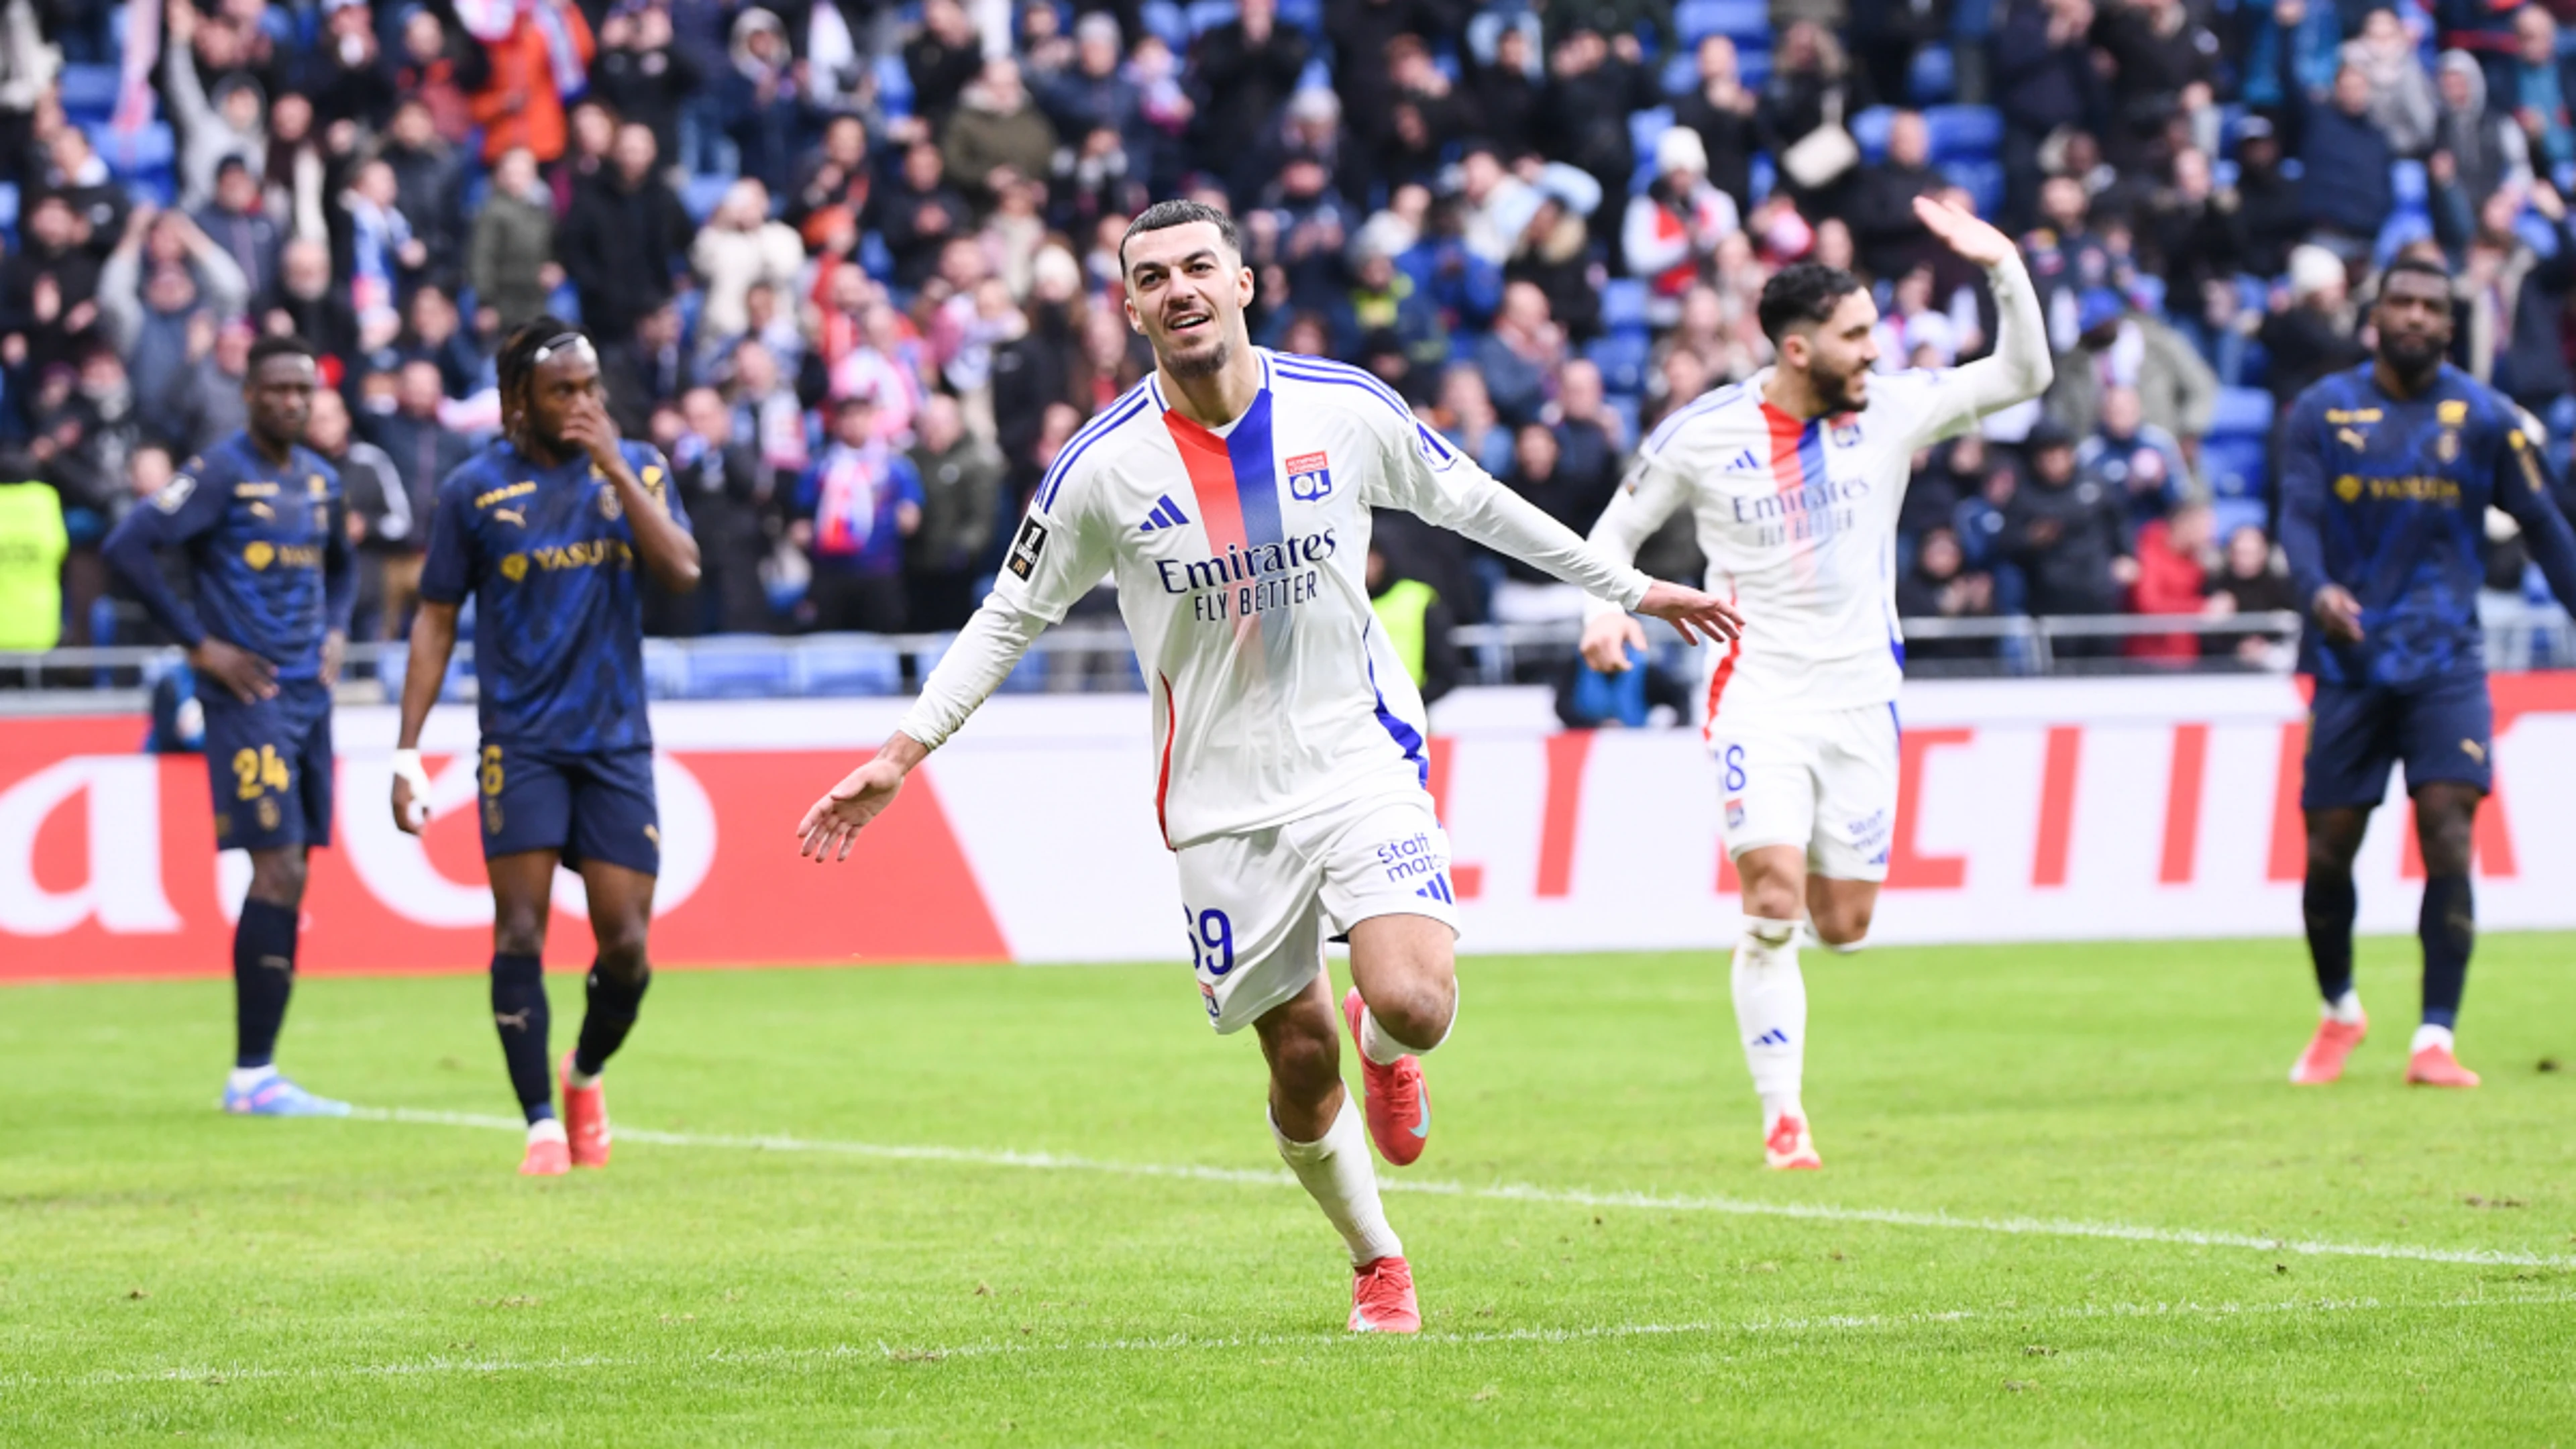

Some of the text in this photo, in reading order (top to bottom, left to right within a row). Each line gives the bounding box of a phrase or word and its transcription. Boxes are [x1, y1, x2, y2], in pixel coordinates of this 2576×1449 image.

[1293, 471, 1330, 496] OL
[533, 539, 633, 570] YASUA
[1155, 527, 1336, 594] Emirates
[1195, 570, 1318, 621] FLY BETTER
[232, 743, 290, 802] 24
[482, 744, 504, 796] 6
